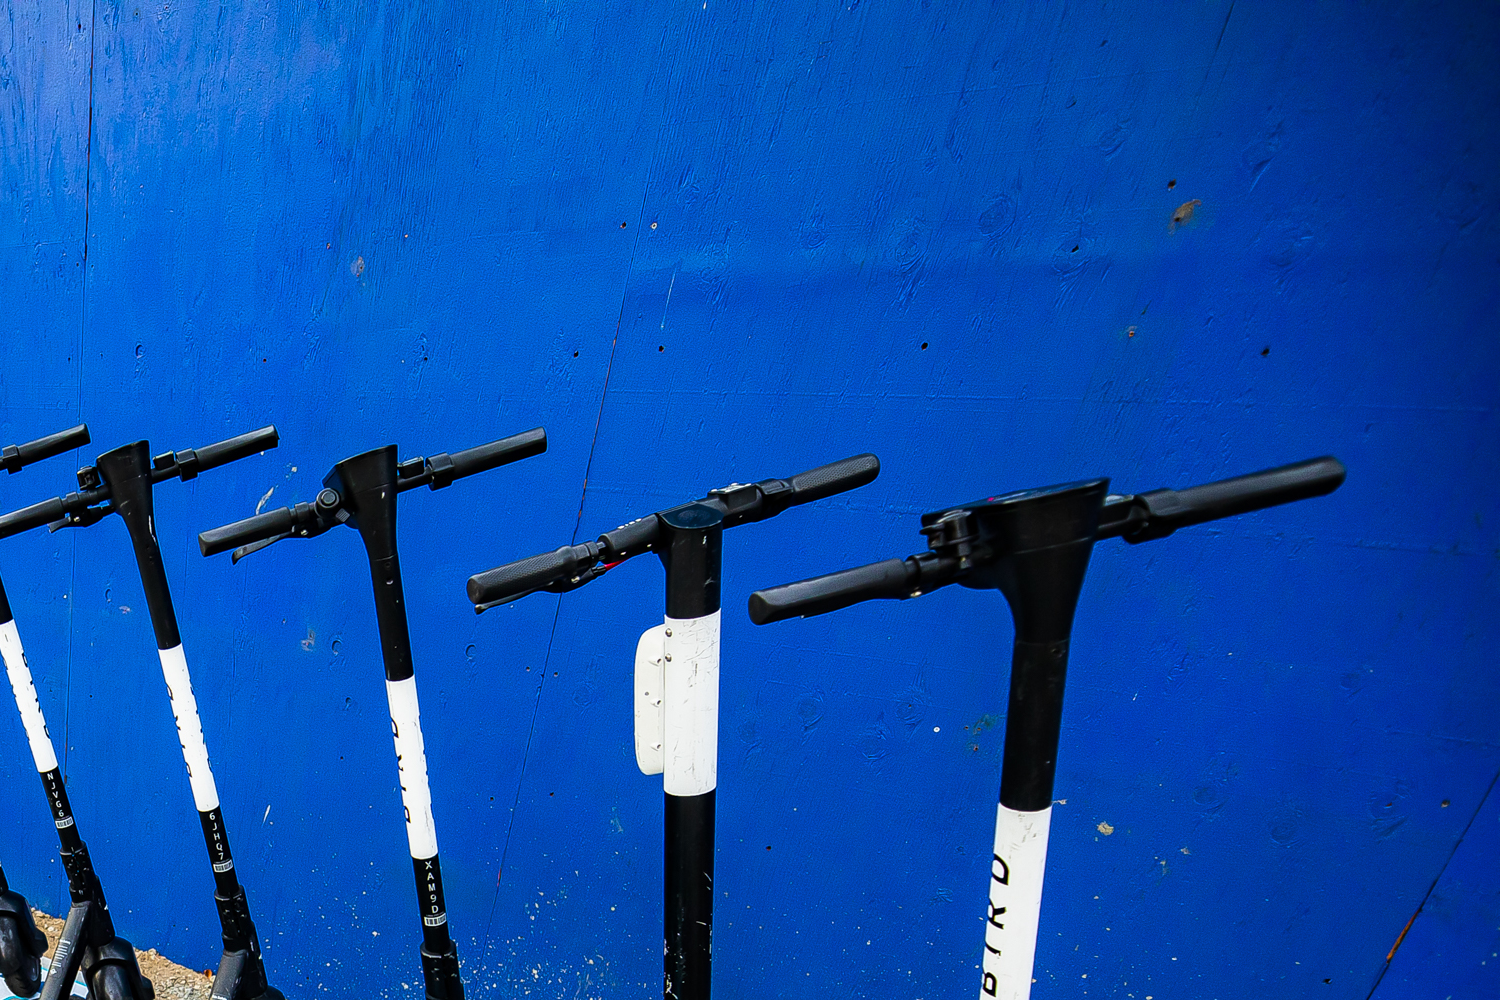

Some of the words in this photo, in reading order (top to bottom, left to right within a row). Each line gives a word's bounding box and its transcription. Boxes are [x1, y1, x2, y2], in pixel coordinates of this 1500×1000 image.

[46, 772, 65, 818] NJVG6
[208, 812, 225, 861] 6JHQ7
[424, 860, 440, 914] XAM9D
[982, 853, 1010, 998] BIRD
